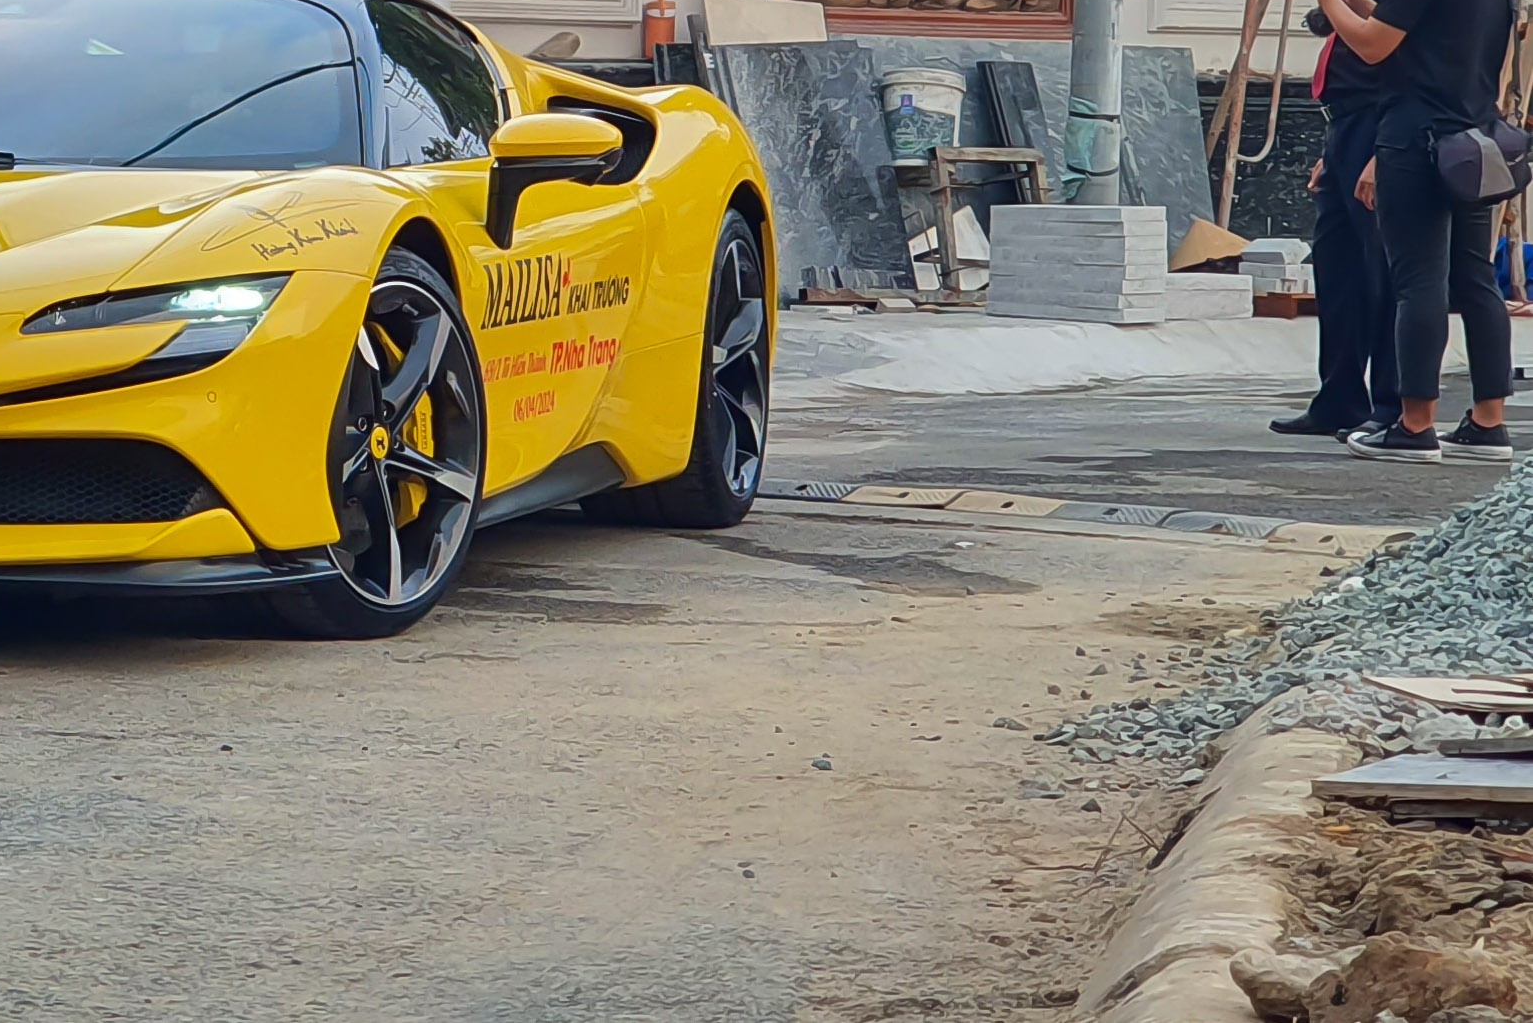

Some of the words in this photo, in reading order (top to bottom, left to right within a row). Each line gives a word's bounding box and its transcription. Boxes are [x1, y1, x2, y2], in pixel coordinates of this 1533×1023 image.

[479, 252, 562, 331] MAILISA
[568, 283, 591, 314] KHAI
[550, 339, 585, 374] TP.Nha
[588, 335, 616, 370] Trang
